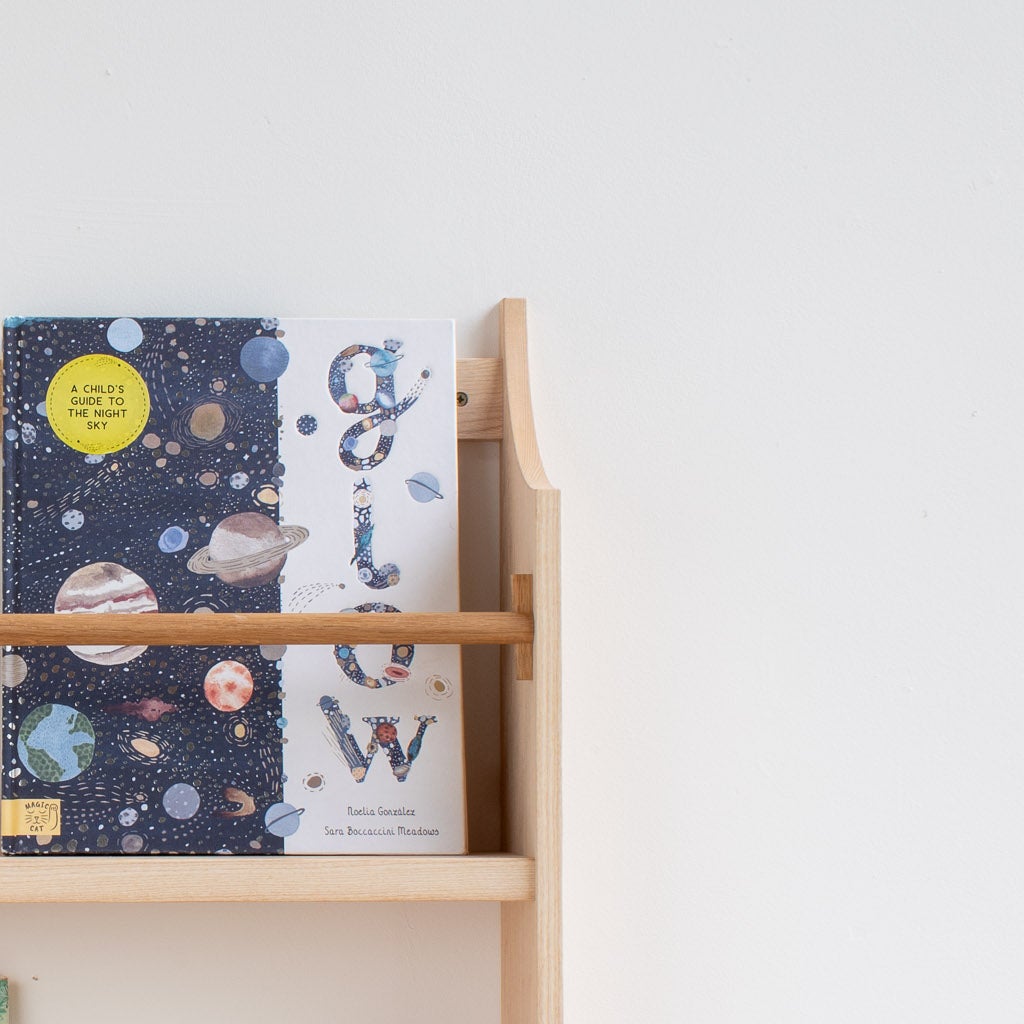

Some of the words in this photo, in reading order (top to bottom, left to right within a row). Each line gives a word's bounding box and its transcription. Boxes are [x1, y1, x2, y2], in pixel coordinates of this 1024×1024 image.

[71, 385, 78, 393] A
[83, 384, 124, 393] CHILD'S
[70, 396, 103, 406] GUIDE
[108, 396, 125, 406] TO
[68, 408, 89, 418] THE
[94, 408, 127, 418] NIGHT
[87, 421, 108, 430] SKY
[25, 801, 49, 810] MAGIC
[324, 825, 344, 836] Sara
[397, 825, 440, 836] Meadows
